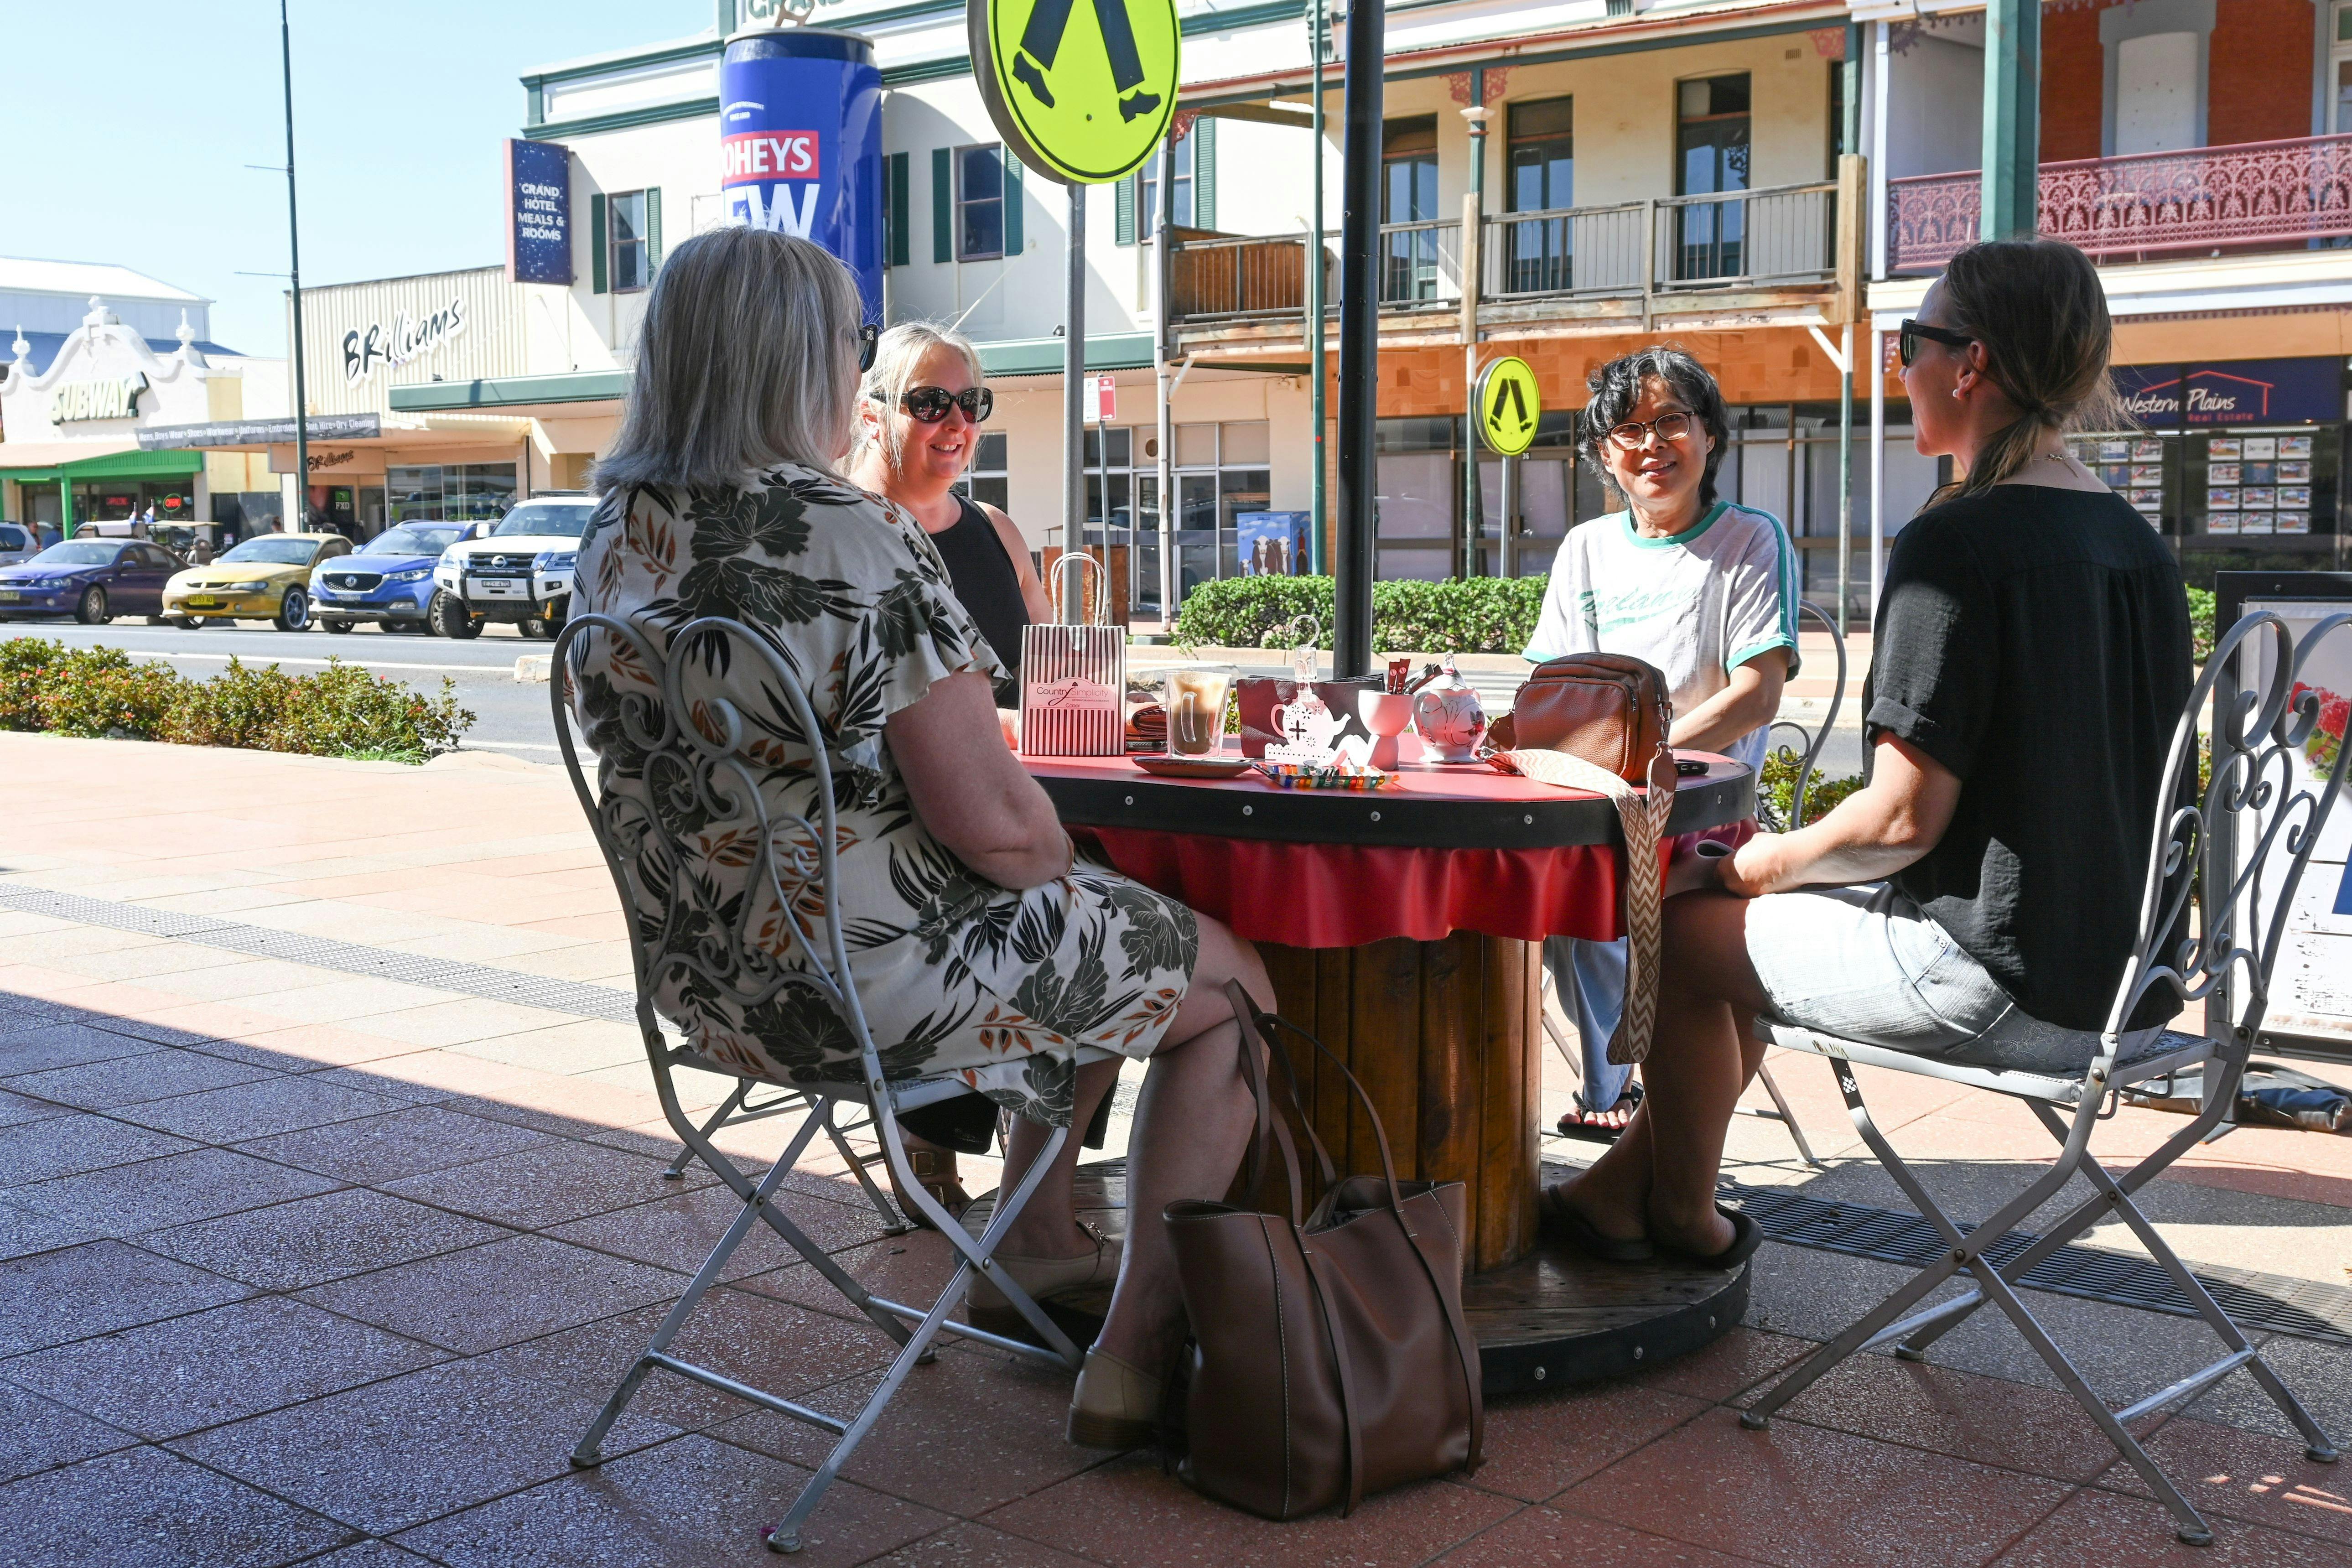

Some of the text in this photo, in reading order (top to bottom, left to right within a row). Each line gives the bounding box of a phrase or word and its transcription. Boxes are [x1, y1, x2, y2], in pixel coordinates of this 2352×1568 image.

[719, 137, 812, 178] OHEYS
[521, 183, 560, 197] GRAND
[524, 198, 557, 211] HOTEL
[518, 212, 565, 227] MEALS &
[522, 228, 561, 241] ROOMS
[51, 371, 149, 425] SUBWAY
[2118, 388, 2236, 412] Western Plains
[169, 431, 183, 439] Wear
[187, 429, 202, 437] Shoes
[206, 427, 234, 436] Workwear
[239, 426, 265, 435] Uniforms
[305, 422, 318, 431] Suit
[319, 421, 332, 430] Hire
[336, 421, 347, 430] Dry
[349, 419, 375, 429] Cleaning
[1037, 687, 1108, 706] Country Simplicity
